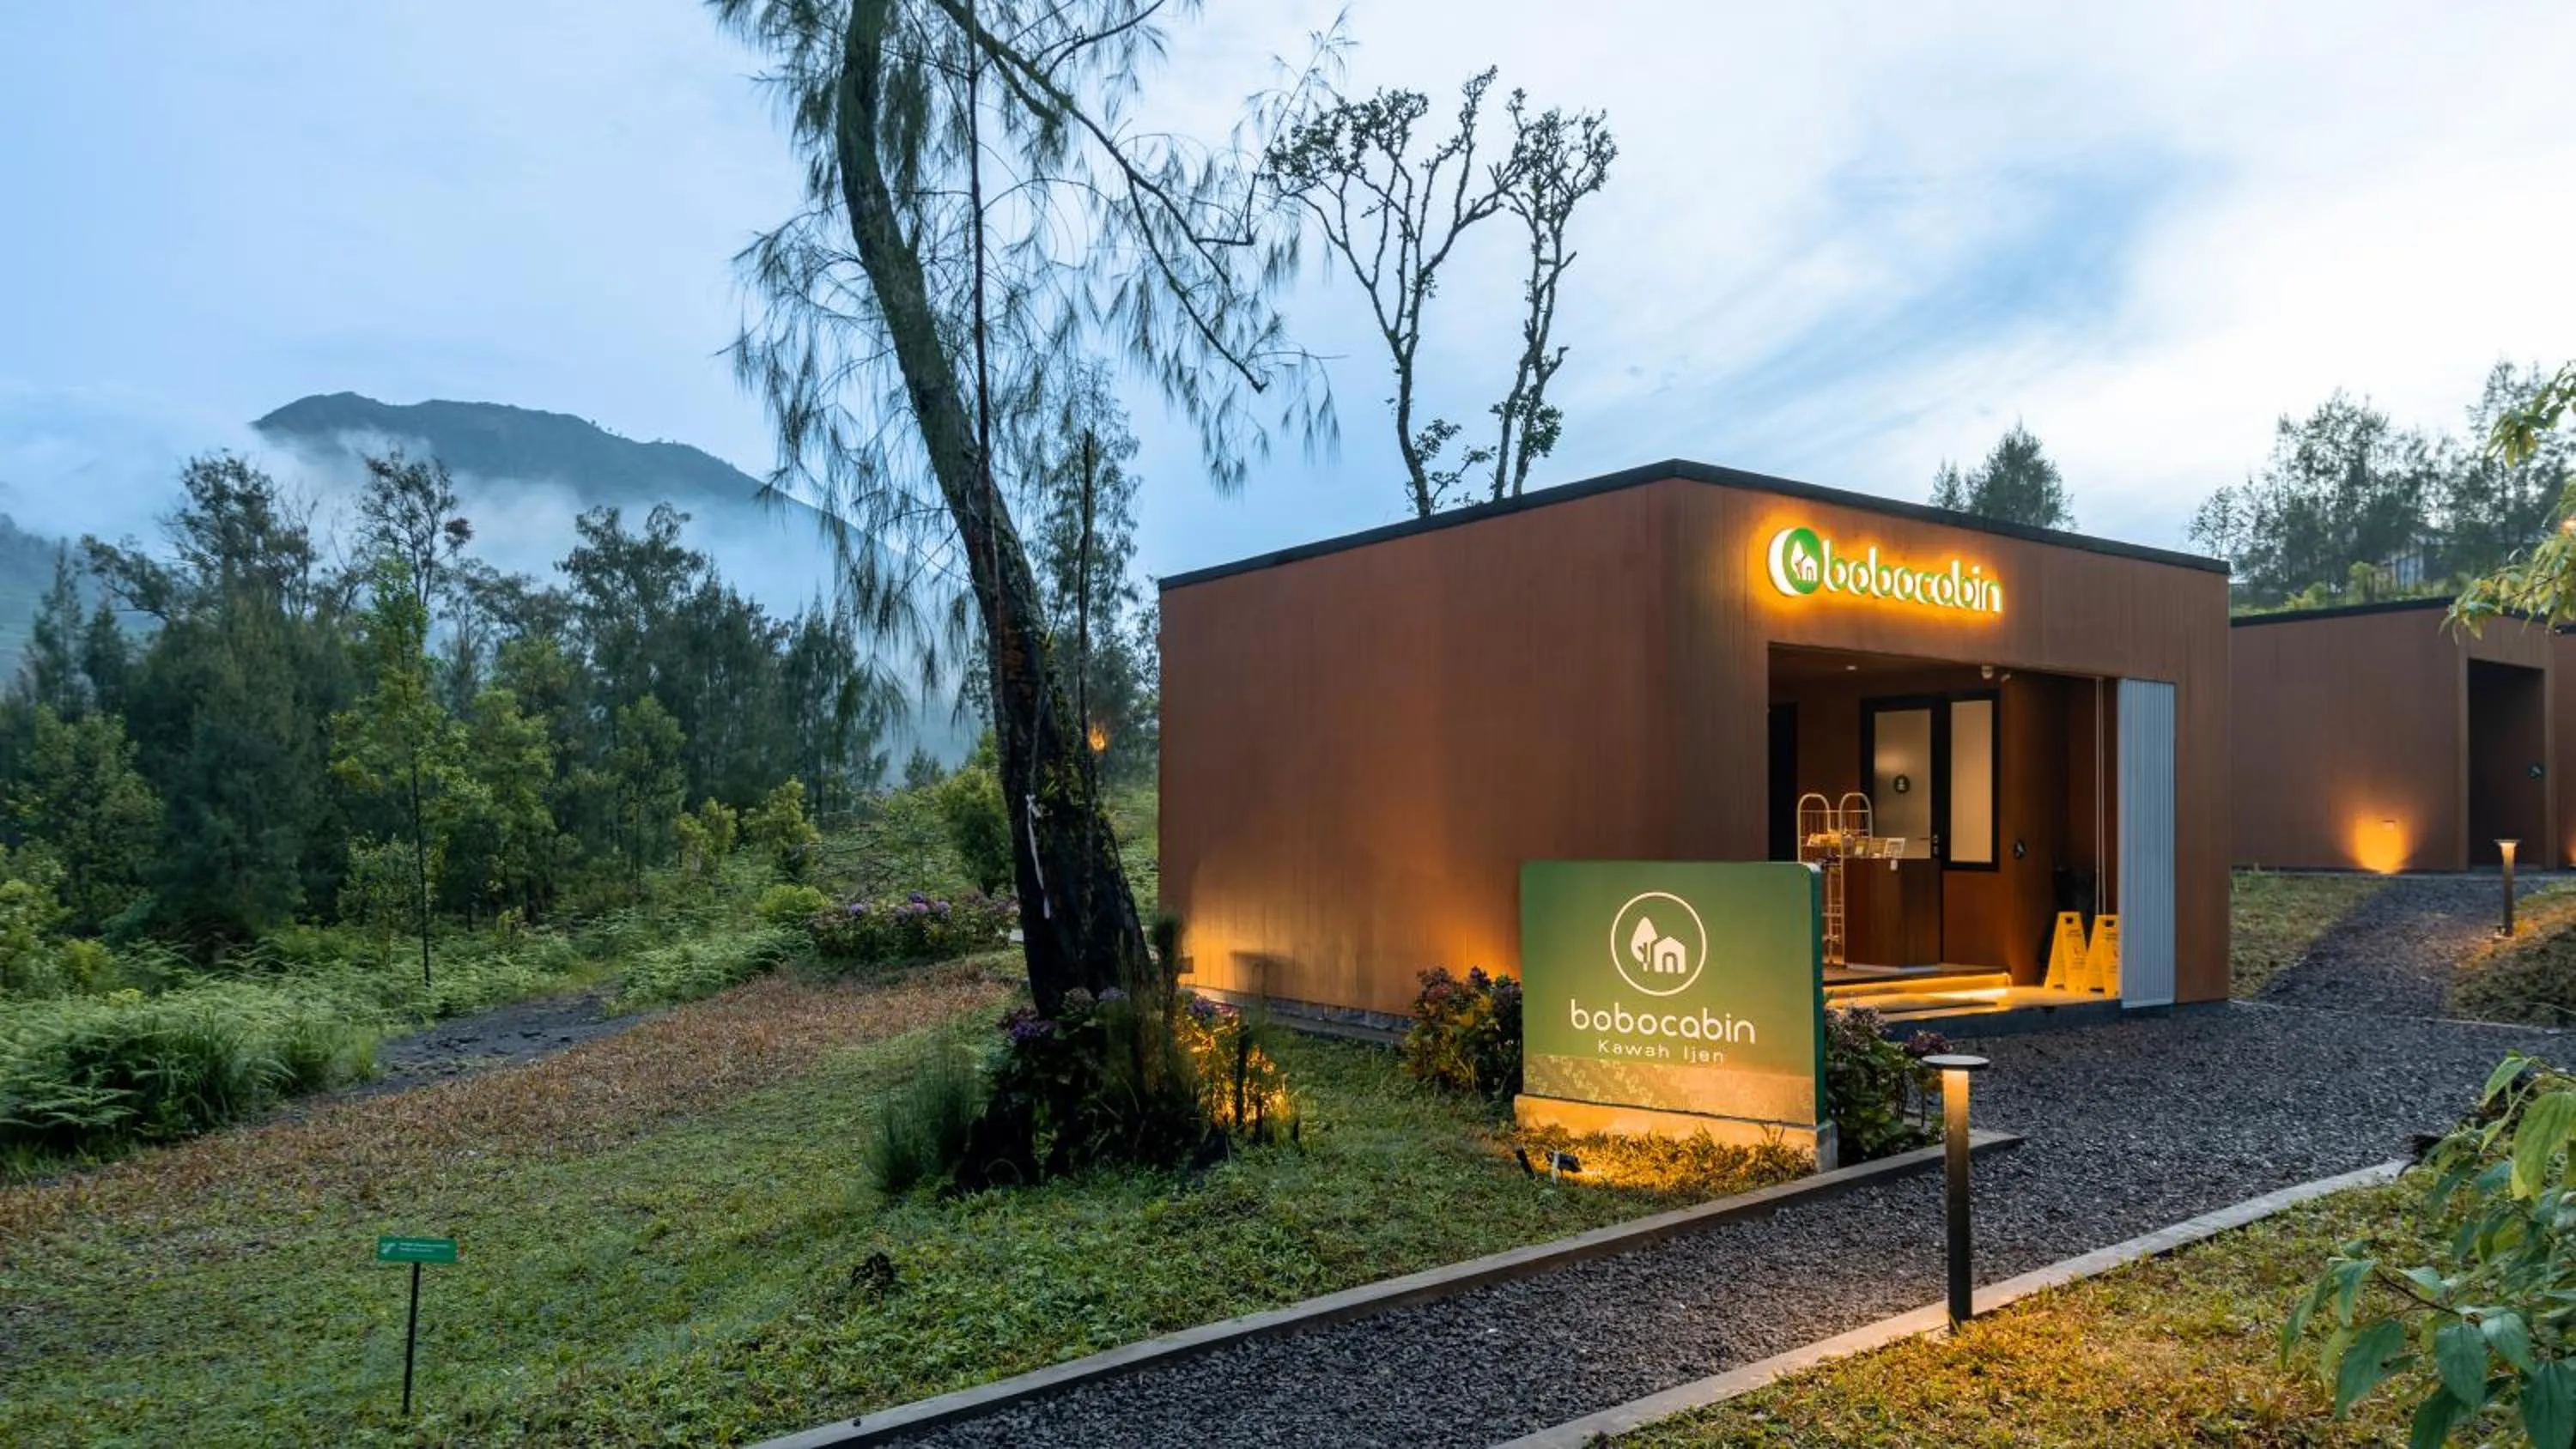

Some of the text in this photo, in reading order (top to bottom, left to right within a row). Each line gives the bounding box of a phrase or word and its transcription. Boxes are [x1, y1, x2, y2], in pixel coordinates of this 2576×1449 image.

[1822, 539, 2003, 613] bobocabin
[1570, 999, 1756, 1044] bobocabin
[1598, 1040, 1724, 1064] Kawah Ijen
